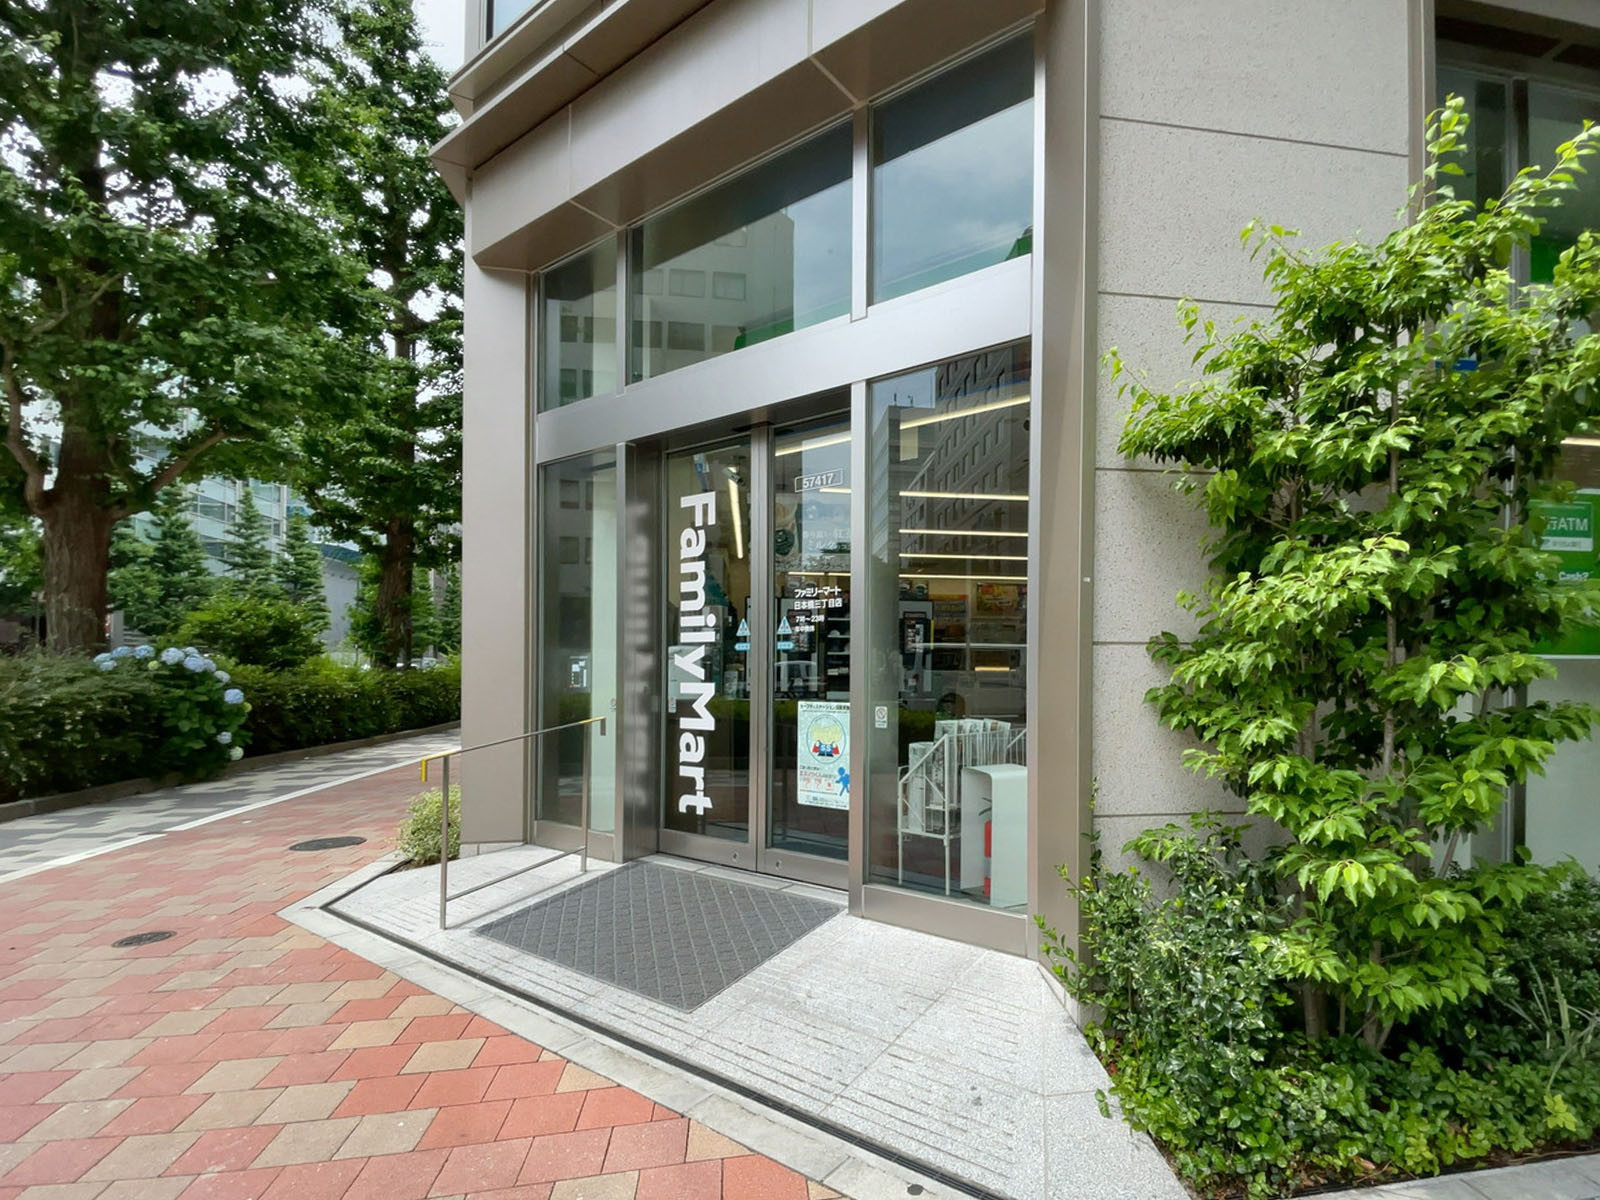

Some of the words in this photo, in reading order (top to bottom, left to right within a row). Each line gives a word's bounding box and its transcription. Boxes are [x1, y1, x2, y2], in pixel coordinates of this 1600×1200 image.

[802, 473, 834, 488] 57417
[794, 585, 842, 598] ファミリーマート
[674, 491, 716, 815] FamilyMart
